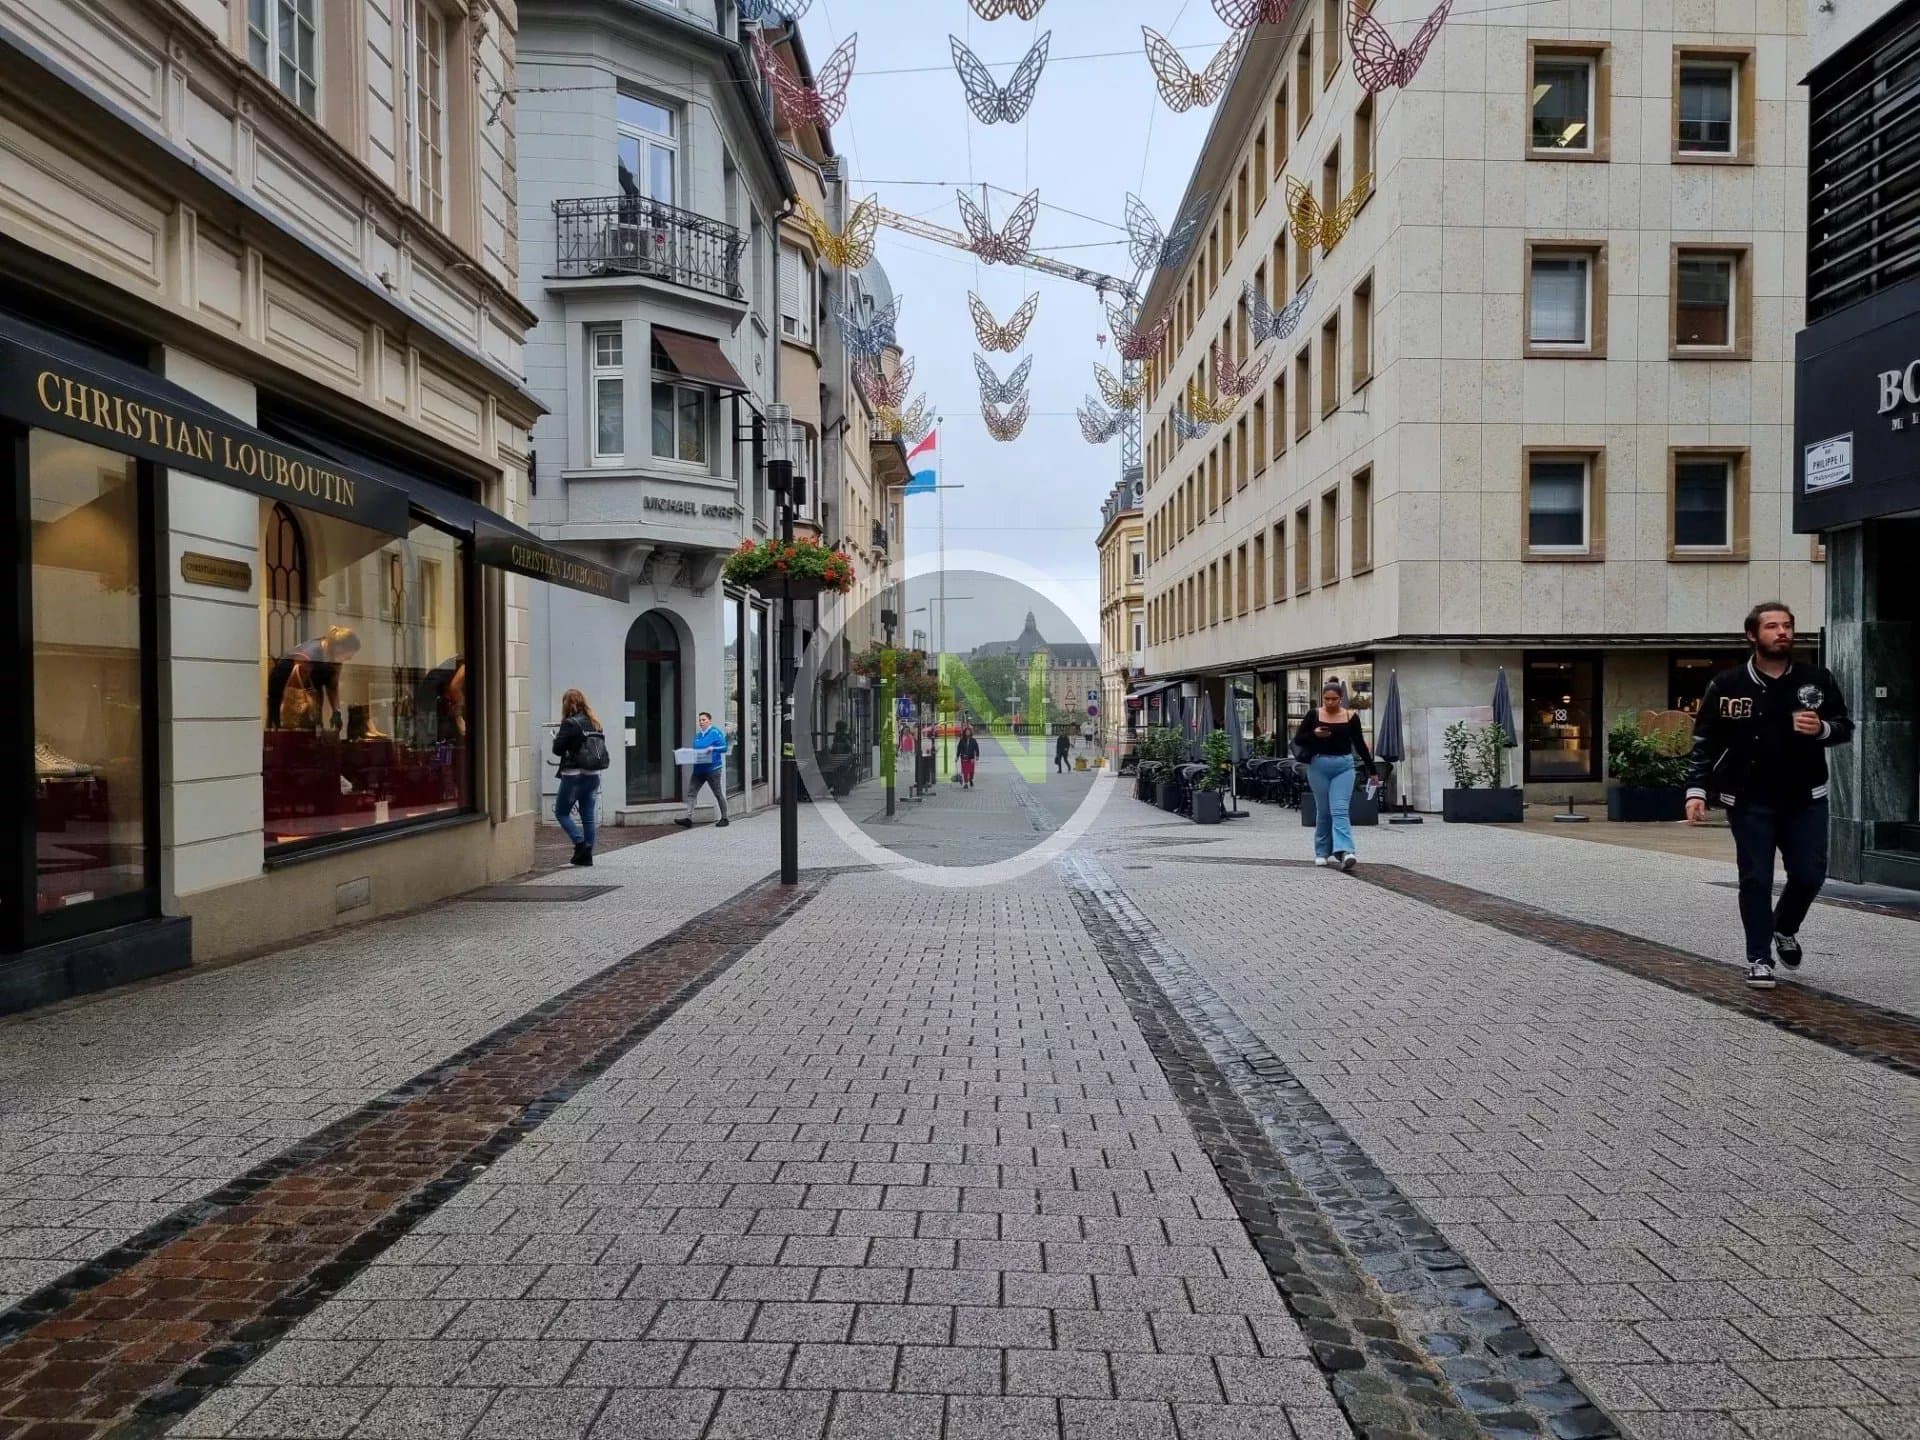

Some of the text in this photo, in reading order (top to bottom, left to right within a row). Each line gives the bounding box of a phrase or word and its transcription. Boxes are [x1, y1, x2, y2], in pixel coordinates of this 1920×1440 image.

[37, 371, 355, 508] CHRISTIAN LOUBOUTIN
[1812, 456, 1838, 470] PHILIPPE
[642, 496, 697, 516] MICHAEL
[511, 544, 608, 591] CHRISTIAN LOUBOUTIN
[1719, 696, 1753, 719] ACE
